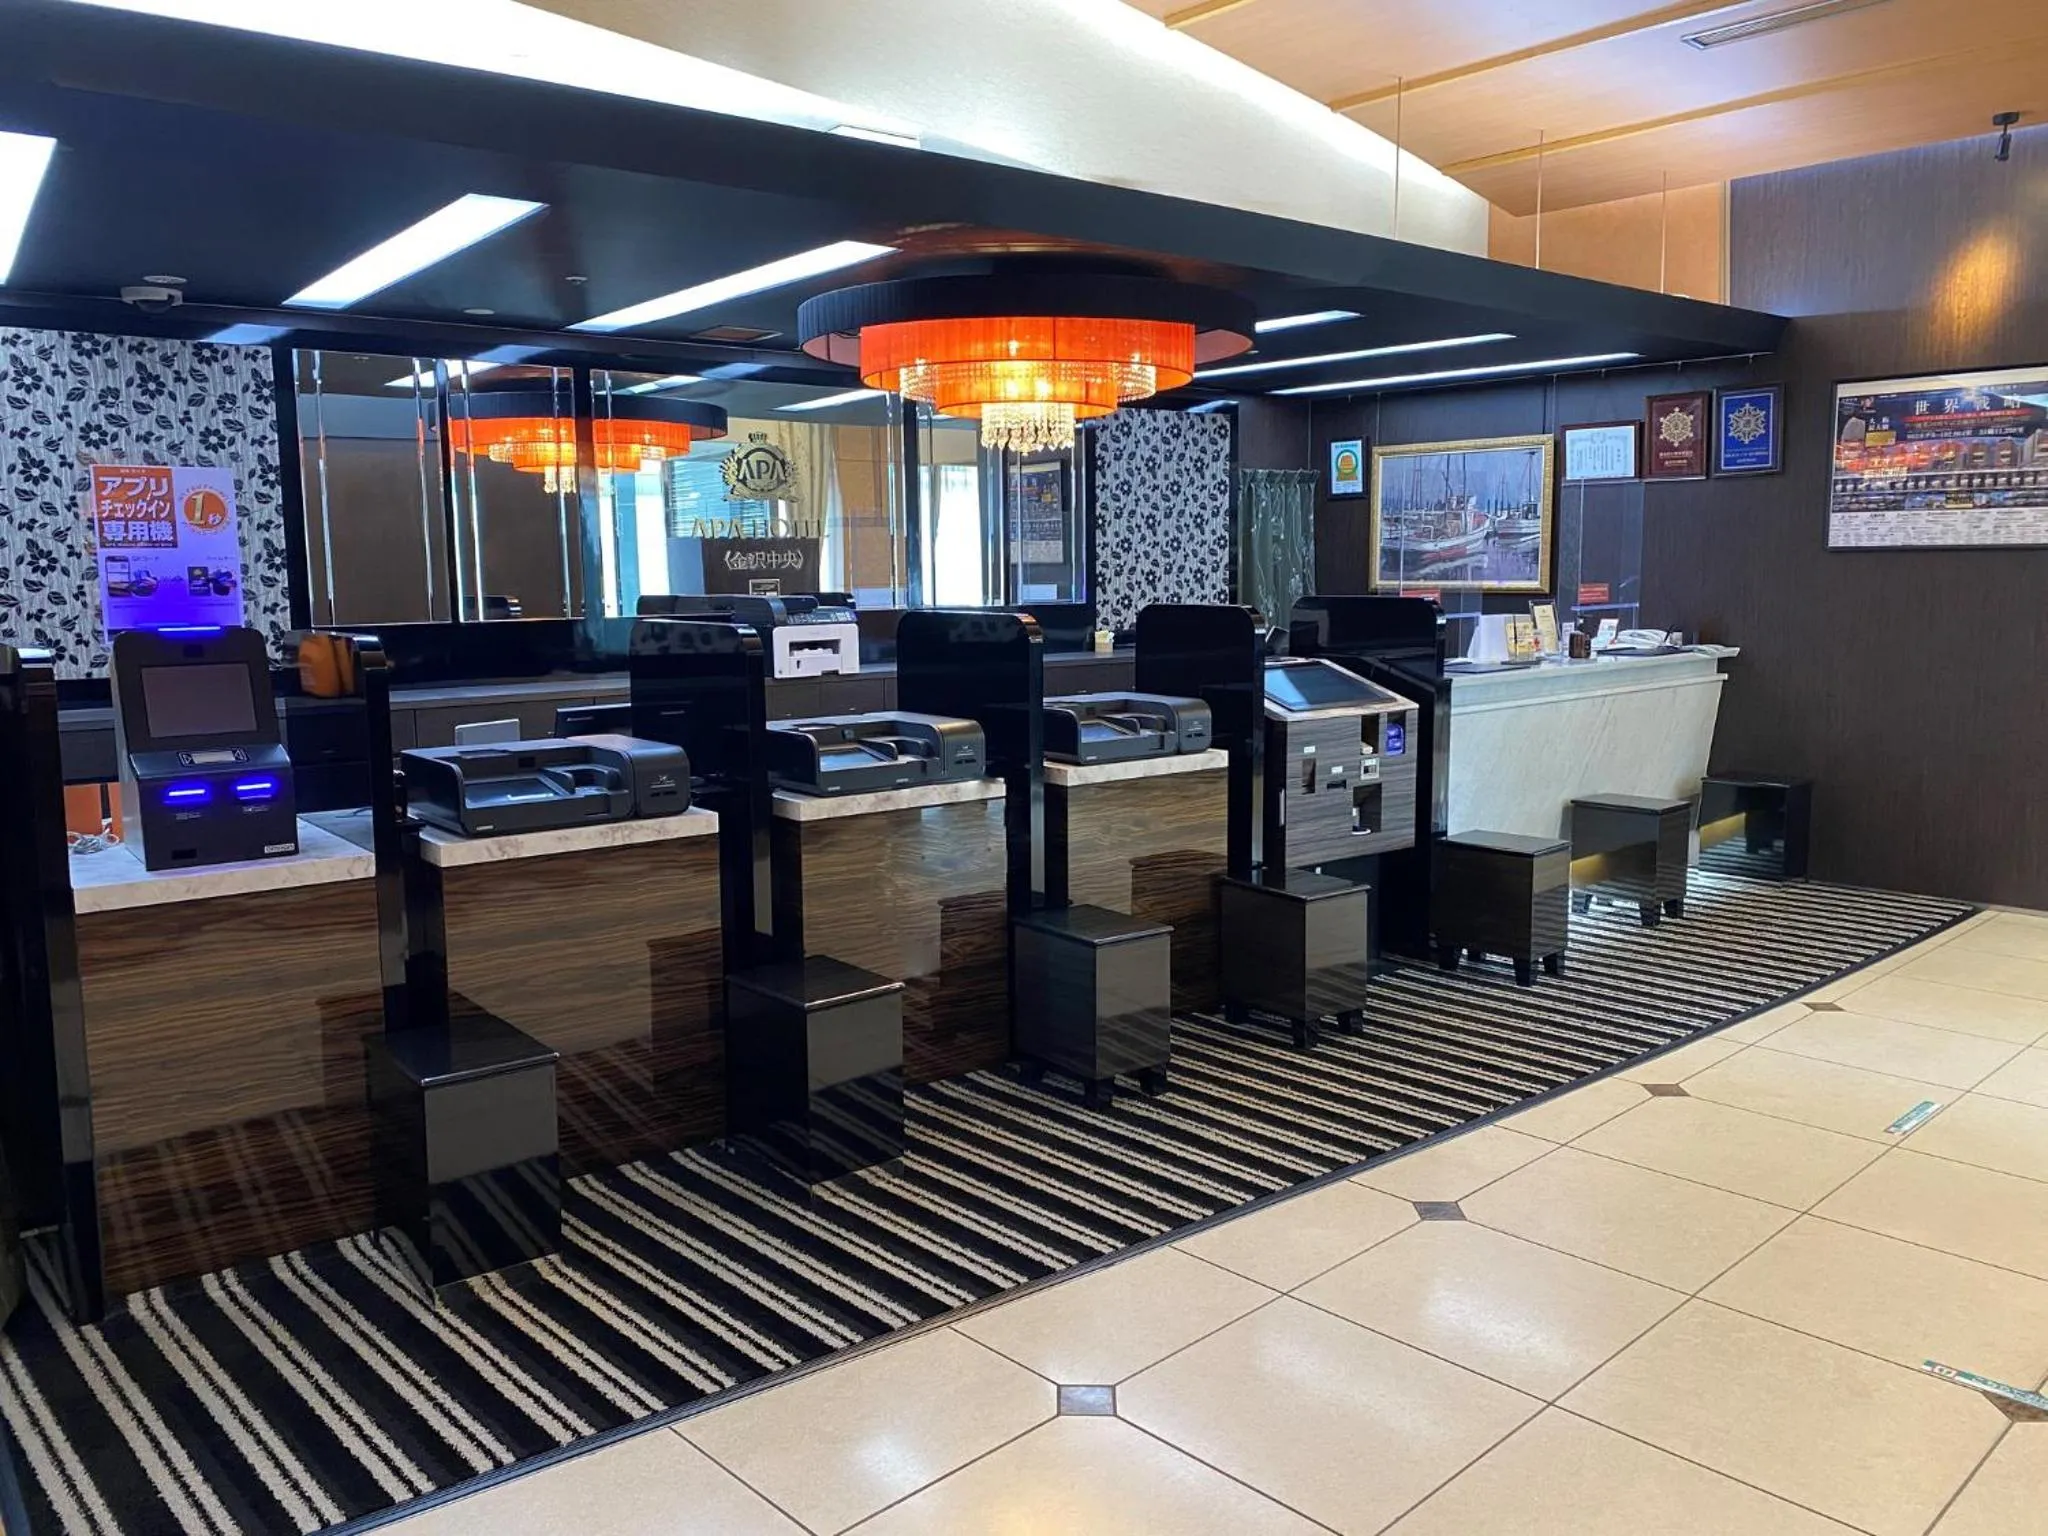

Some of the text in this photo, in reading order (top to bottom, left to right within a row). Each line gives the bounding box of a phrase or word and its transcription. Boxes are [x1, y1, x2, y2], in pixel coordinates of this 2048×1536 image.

[738, 459, 785, 480] APA
[99, 476, 169, 497] アプリ
[100, 499, 171, 518] チェックイン
[102, 520, 174, 542] 専用機
[692, 518, 743, 540] APA
